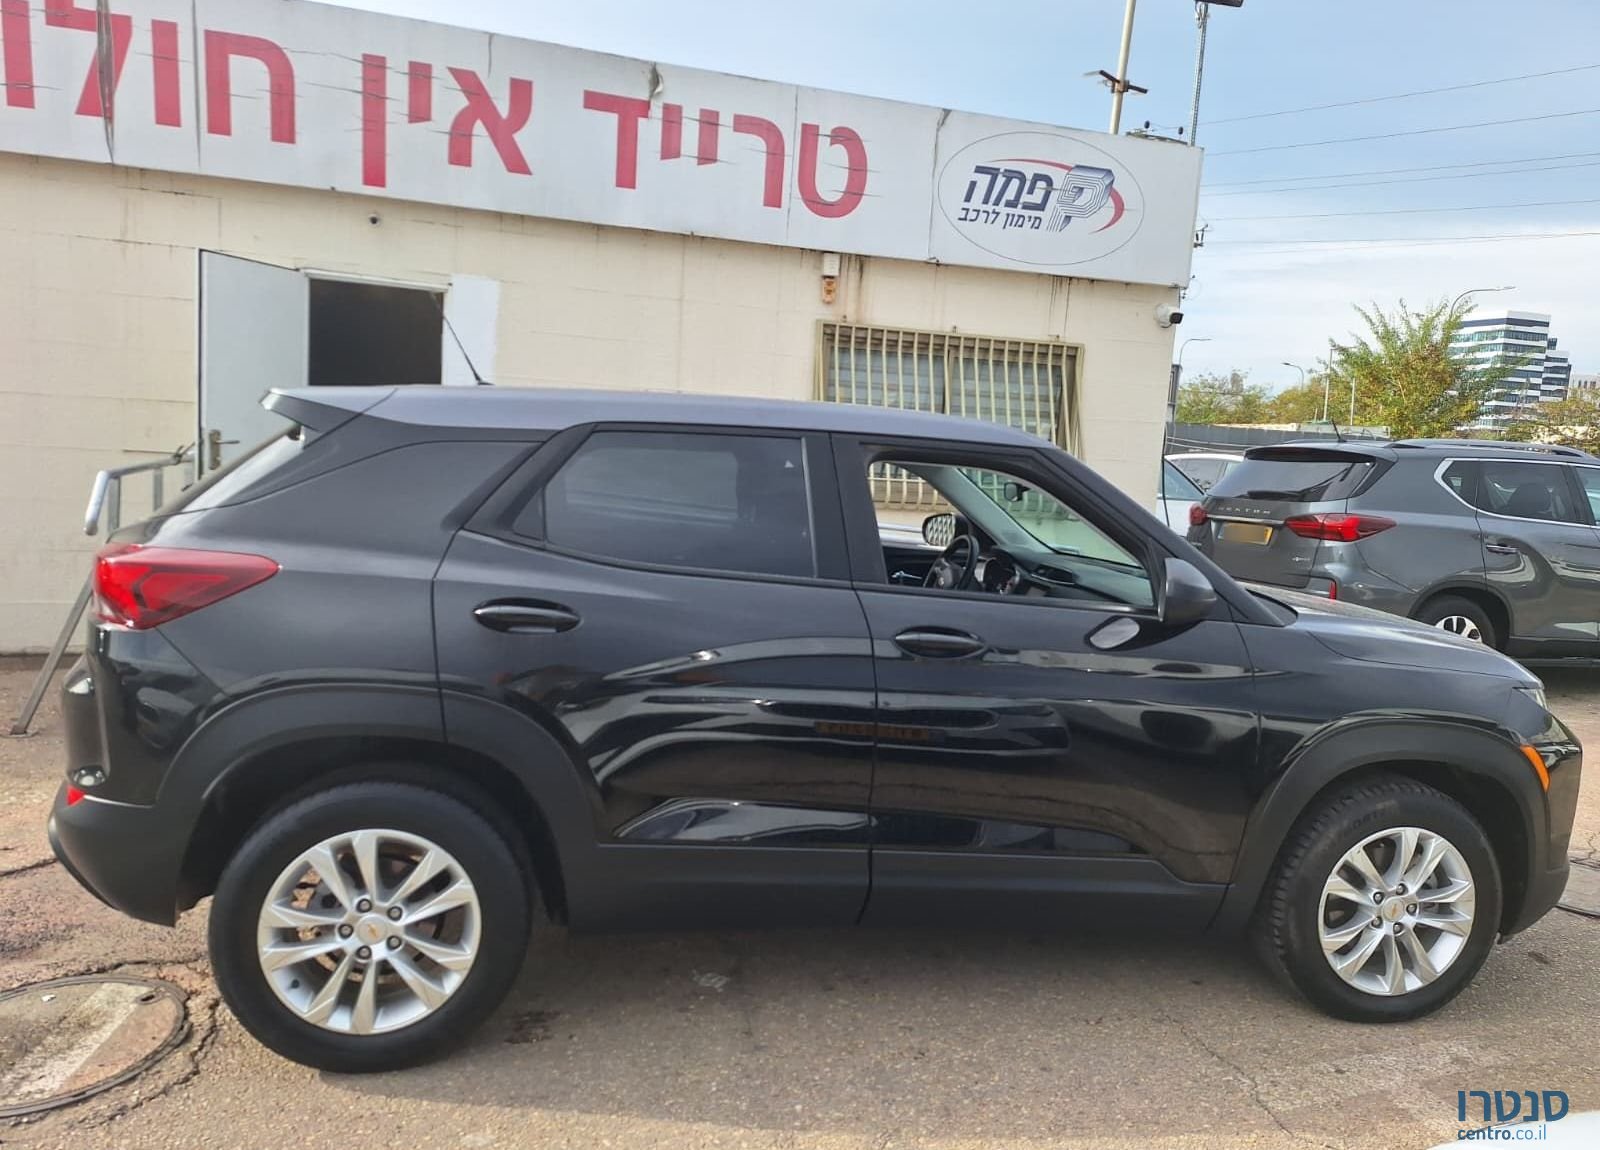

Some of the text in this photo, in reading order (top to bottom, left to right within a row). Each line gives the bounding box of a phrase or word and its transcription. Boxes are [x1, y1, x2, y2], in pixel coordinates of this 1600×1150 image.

[361, 52, 534, 189] אין
[583, 89, 868, 219] טרייד
[957, 206, 1043, 230] מימון לרכב
[963, 165, 1054, 212] פמה
